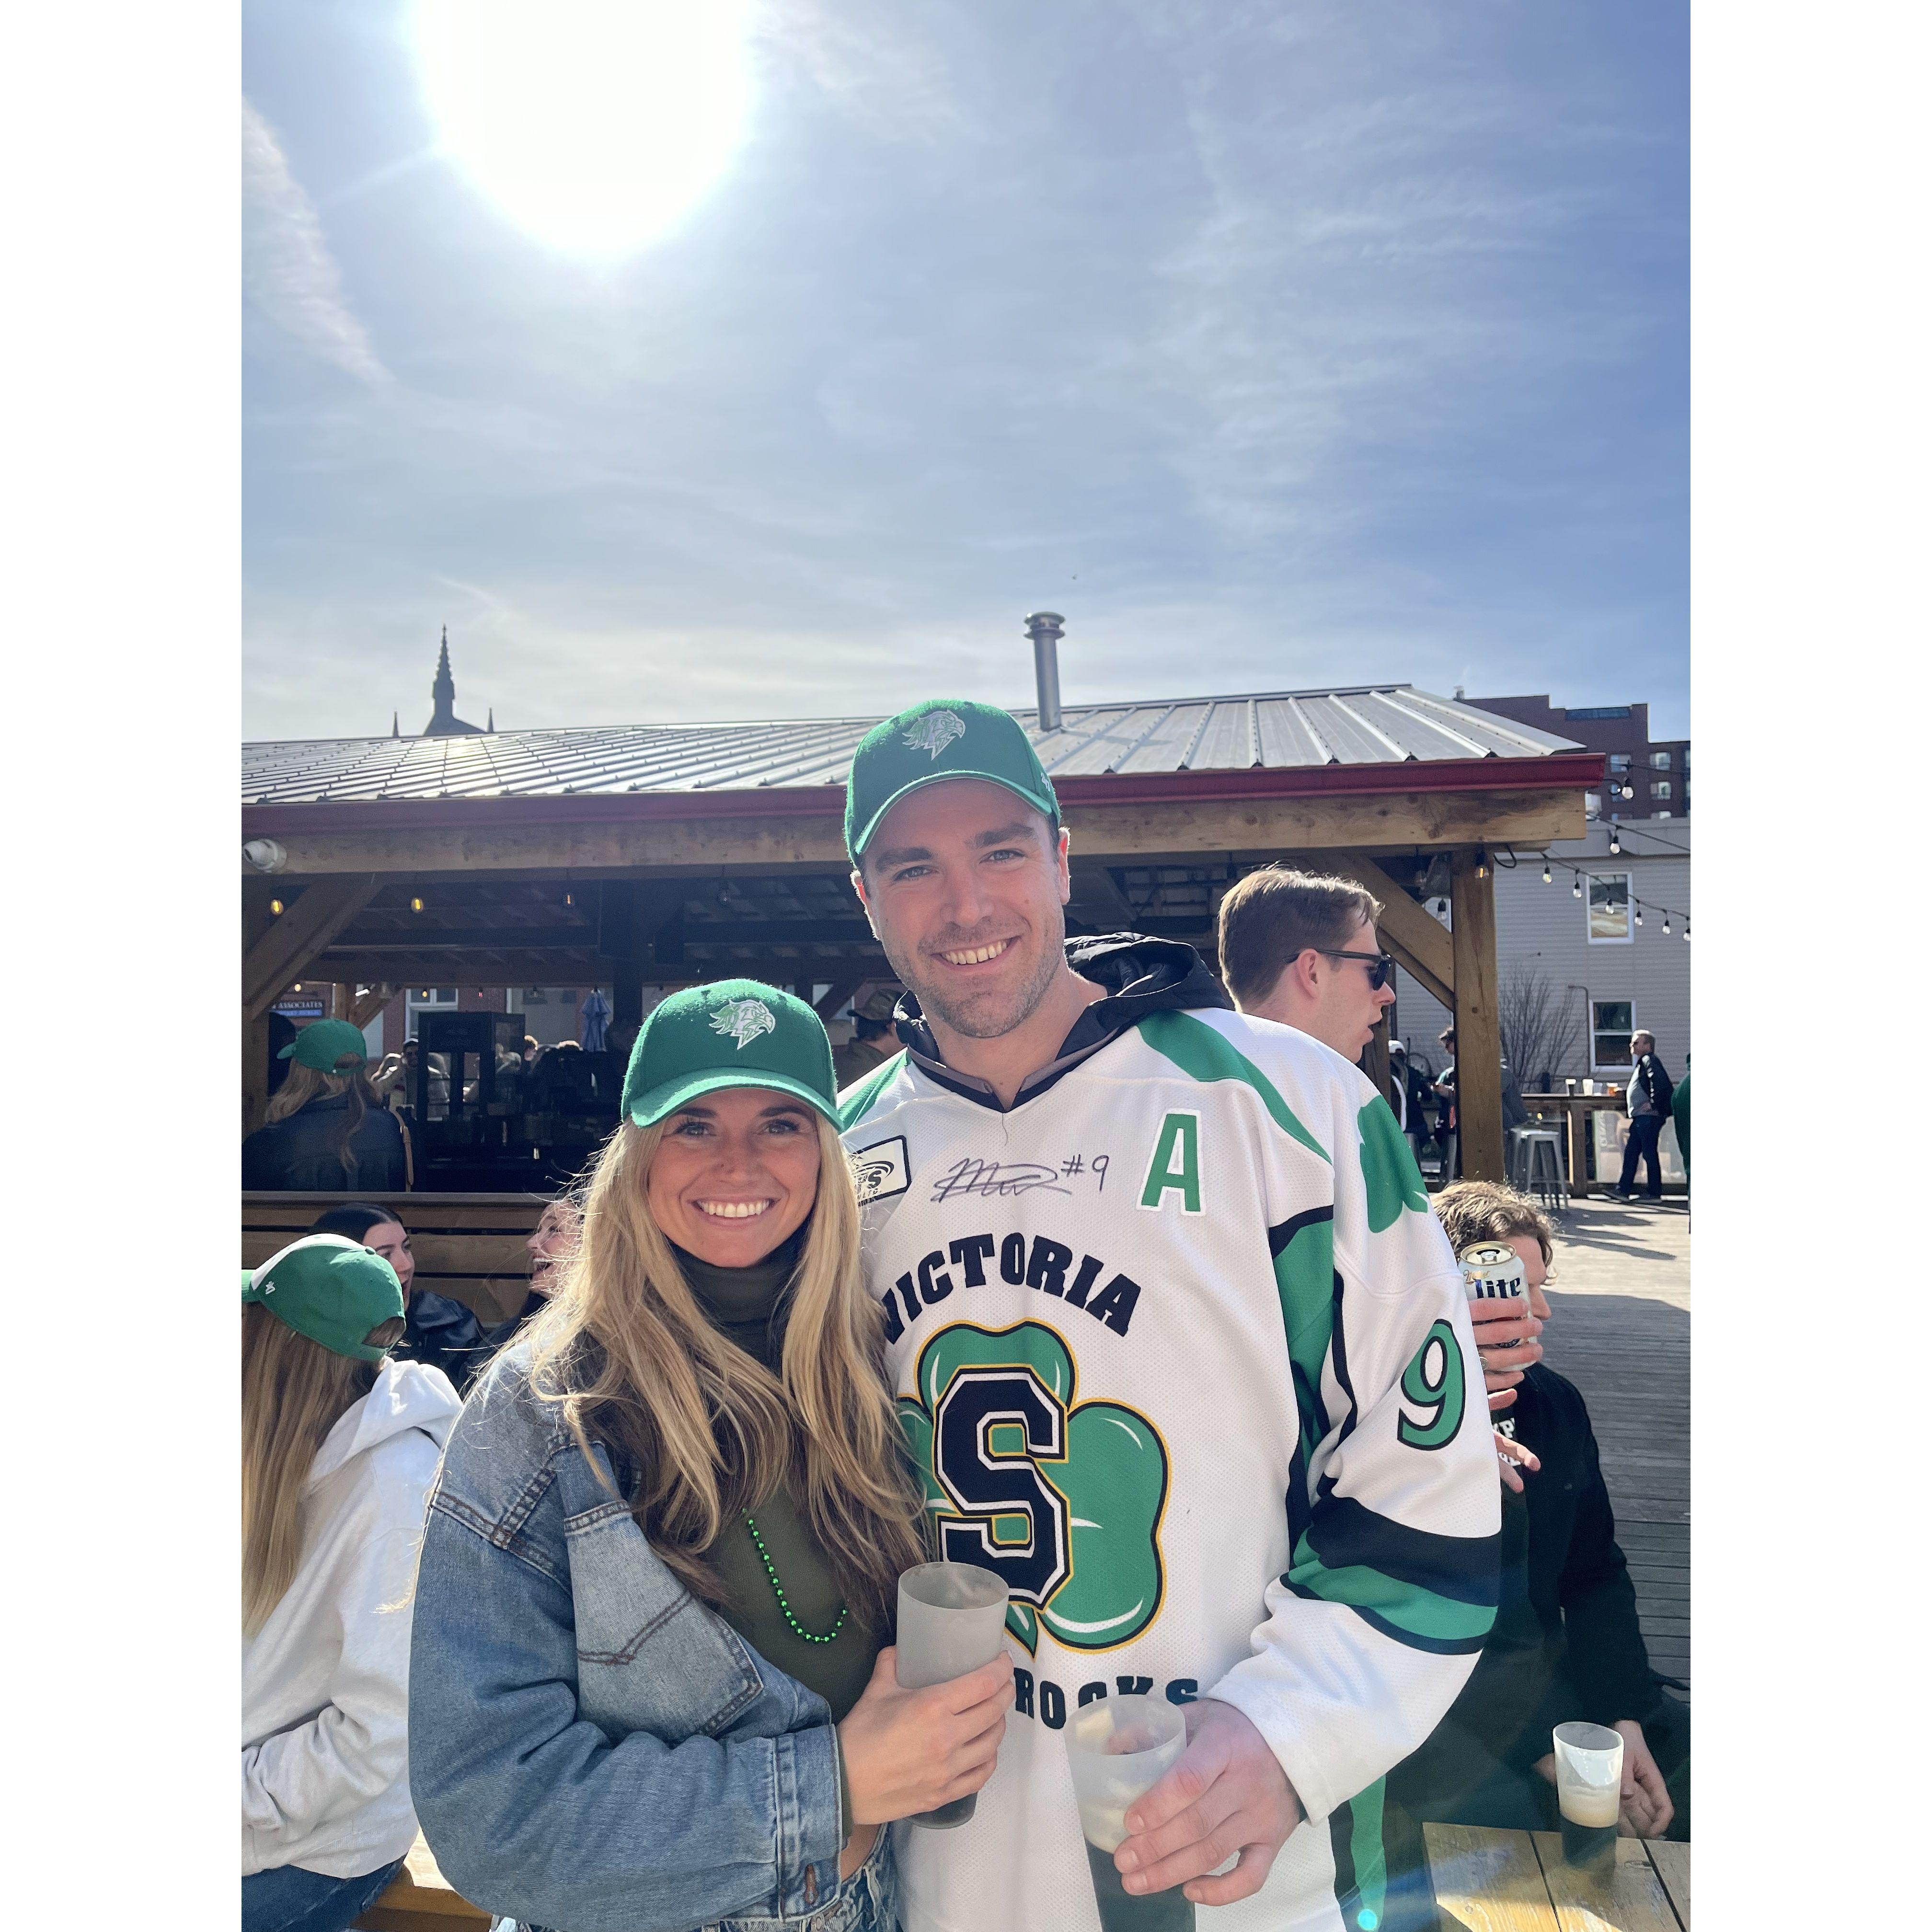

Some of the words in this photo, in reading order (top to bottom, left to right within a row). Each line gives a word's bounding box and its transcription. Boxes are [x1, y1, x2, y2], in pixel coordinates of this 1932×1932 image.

[1136, 1108, 1206, 1217] A
[881, 1232, 1141, 1345] VICTORIA
[1473, 1276, 1522, 1299] lite
[1397, 1319, 1466, 1451] 9
[932, 1364, 1074, 1614] S
